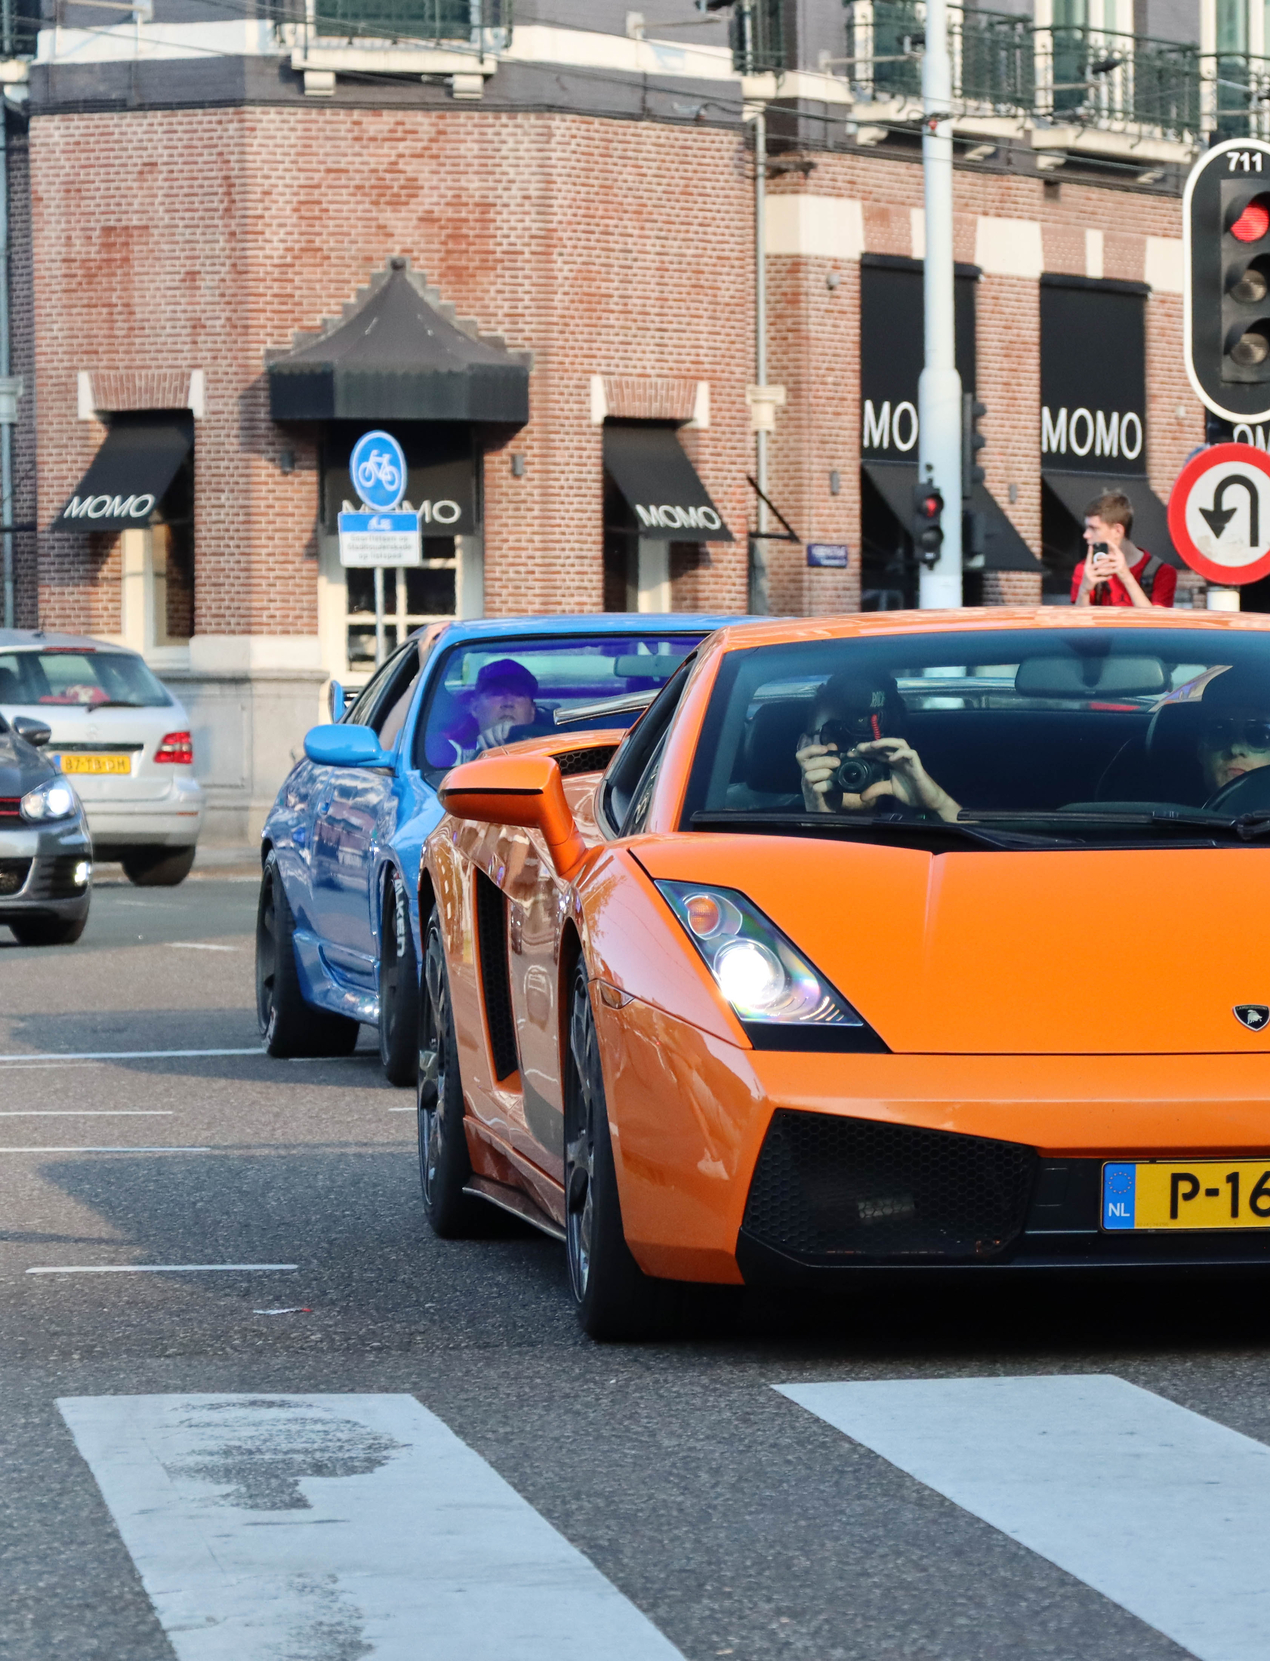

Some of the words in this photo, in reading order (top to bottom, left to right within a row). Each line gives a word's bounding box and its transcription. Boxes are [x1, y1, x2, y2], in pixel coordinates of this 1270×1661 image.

[1226, 151, 1263, 172] 711
[1041, 405, 1143, 460] MOMO
[63, 493, 156, 519] MOMO
[635, 504, 722, 531] MOMO
[1108, 1202, 1131, 1217] NL
